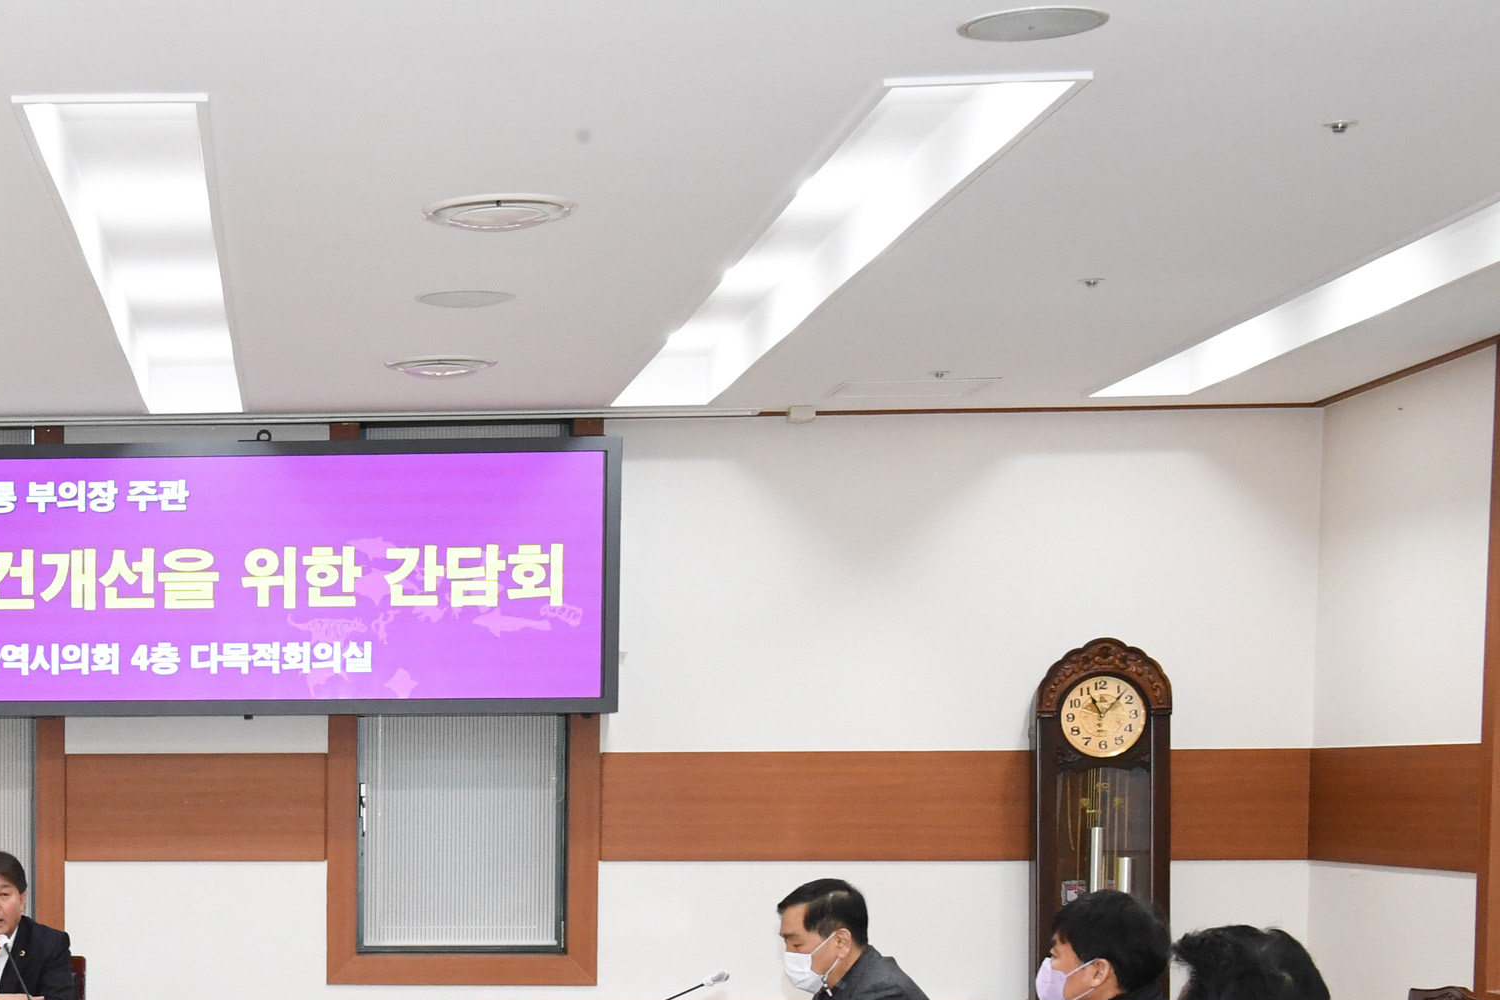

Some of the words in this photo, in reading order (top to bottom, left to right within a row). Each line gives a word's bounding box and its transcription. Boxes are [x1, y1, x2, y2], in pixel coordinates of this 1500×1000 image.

[25, 479, 119, 513] 부의장
[126, 479, 190, 512] 주관
[241, 545, 363, 610] 위한
[383, 543, 564, 608] 간담회
[130, 642, 181, 675] 4층
[190, 640, 373, 675] 다목적회의실
[1094, 680, 1107, 691] 12
[1116, 685, 1121, 694] 1
[1080, 687, 1091, 696] 11
[1069, 698, 1081, 708] 10
[1125, 695, 1134, 705] 2
[1066, 713, 1075, 722] 9
[1129, 709, 1138, 719] 3
[1071, 726, 1080, 736] 8
[1124, 724, 1133, 732] 4
[1082, 737, 1092, 746] 7
[1099, 740, 1107, 750] 6
[1114, 735, 1124, 745] 5
